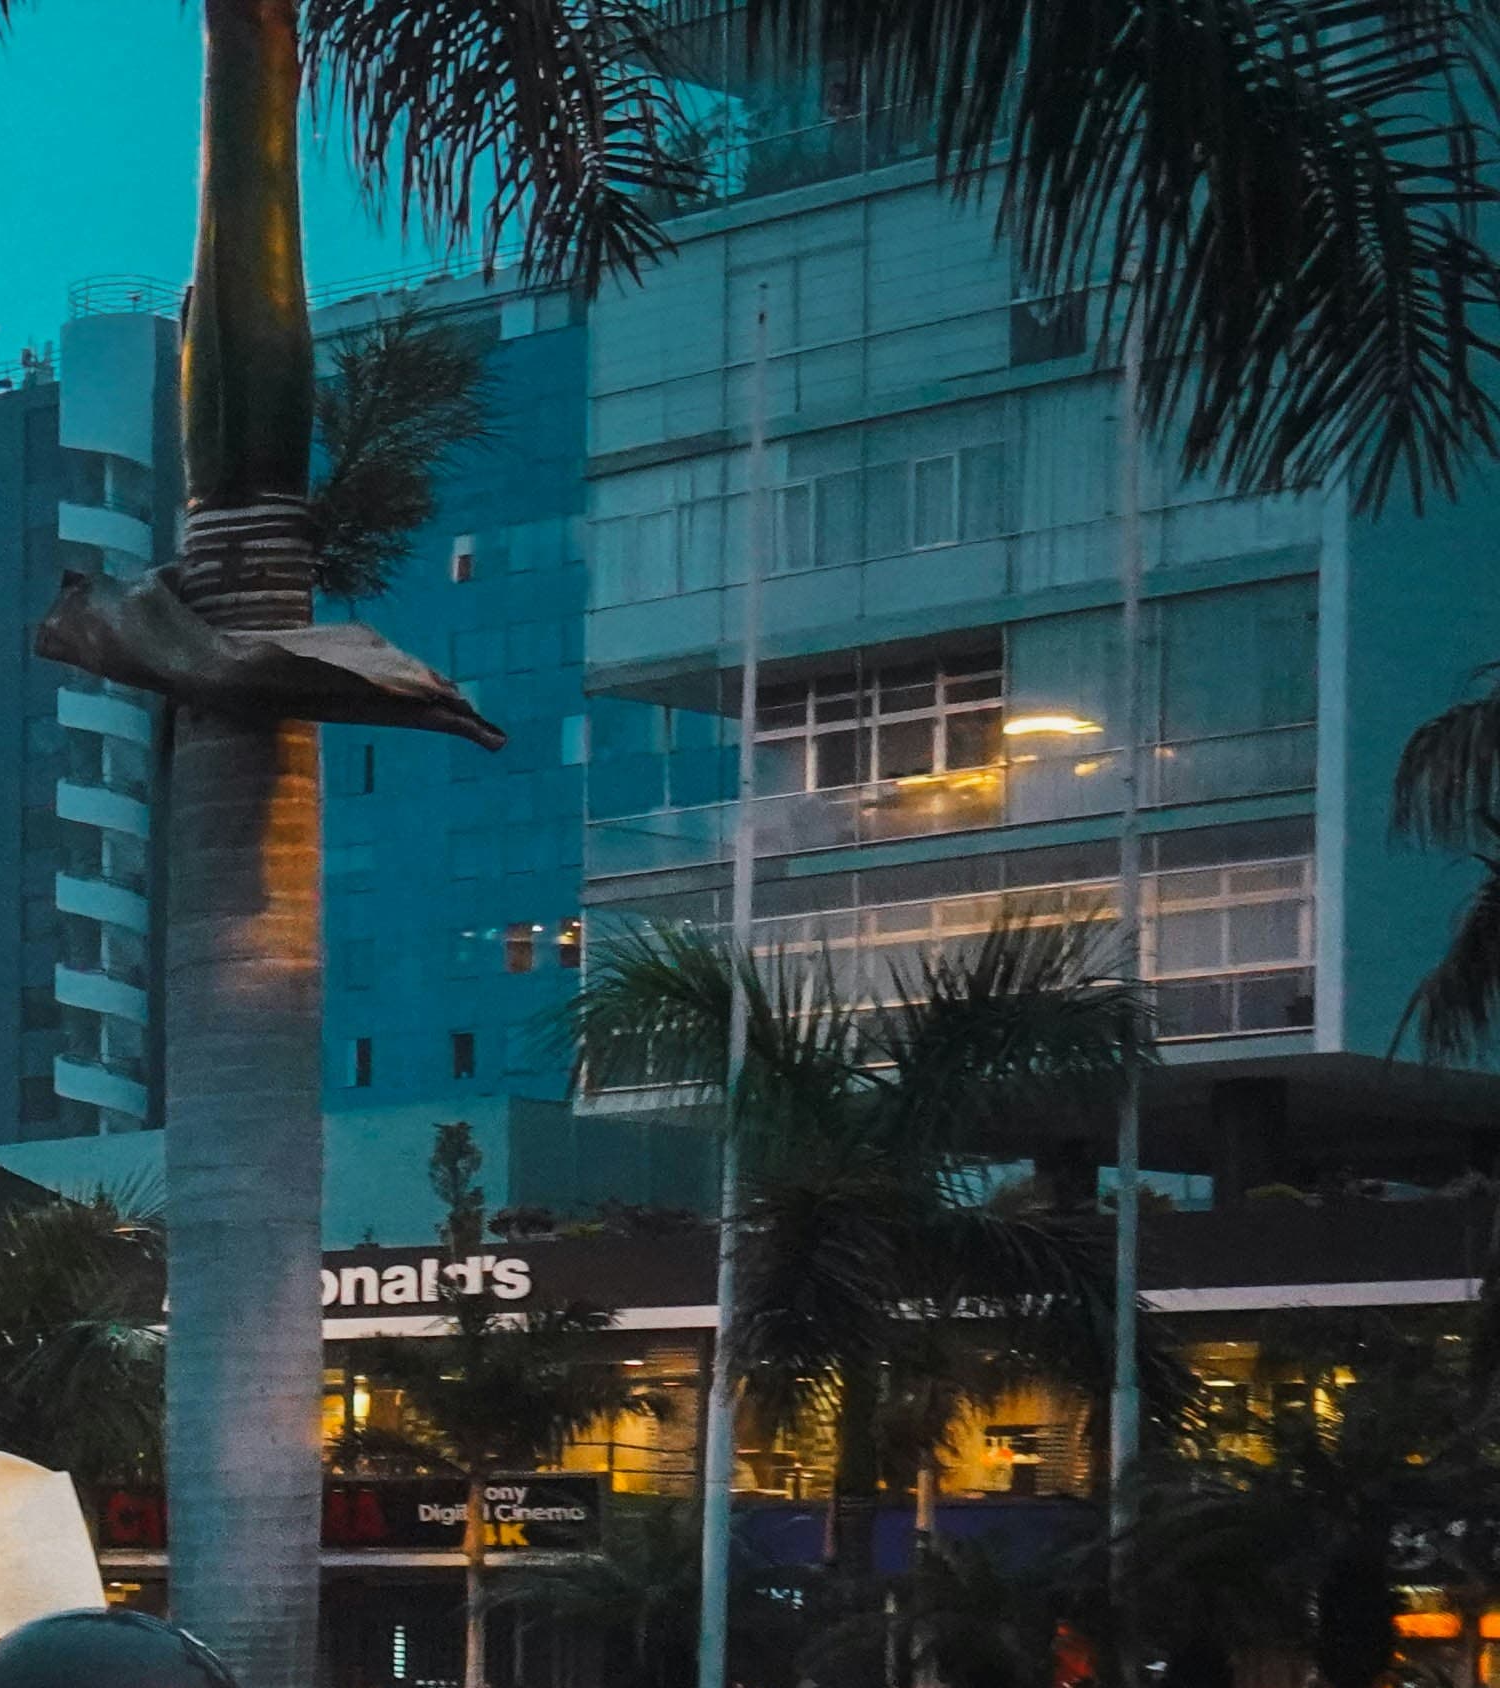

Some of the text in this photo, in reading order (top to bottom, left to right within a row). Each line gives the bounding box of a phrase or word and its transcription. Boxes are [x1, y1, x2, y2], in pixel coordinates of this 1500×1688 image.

[320, 1256, 531, 1306] onald's
[484, 1486, 528, 1504] ony
[418, 1503, 490, 1525] Digitl
